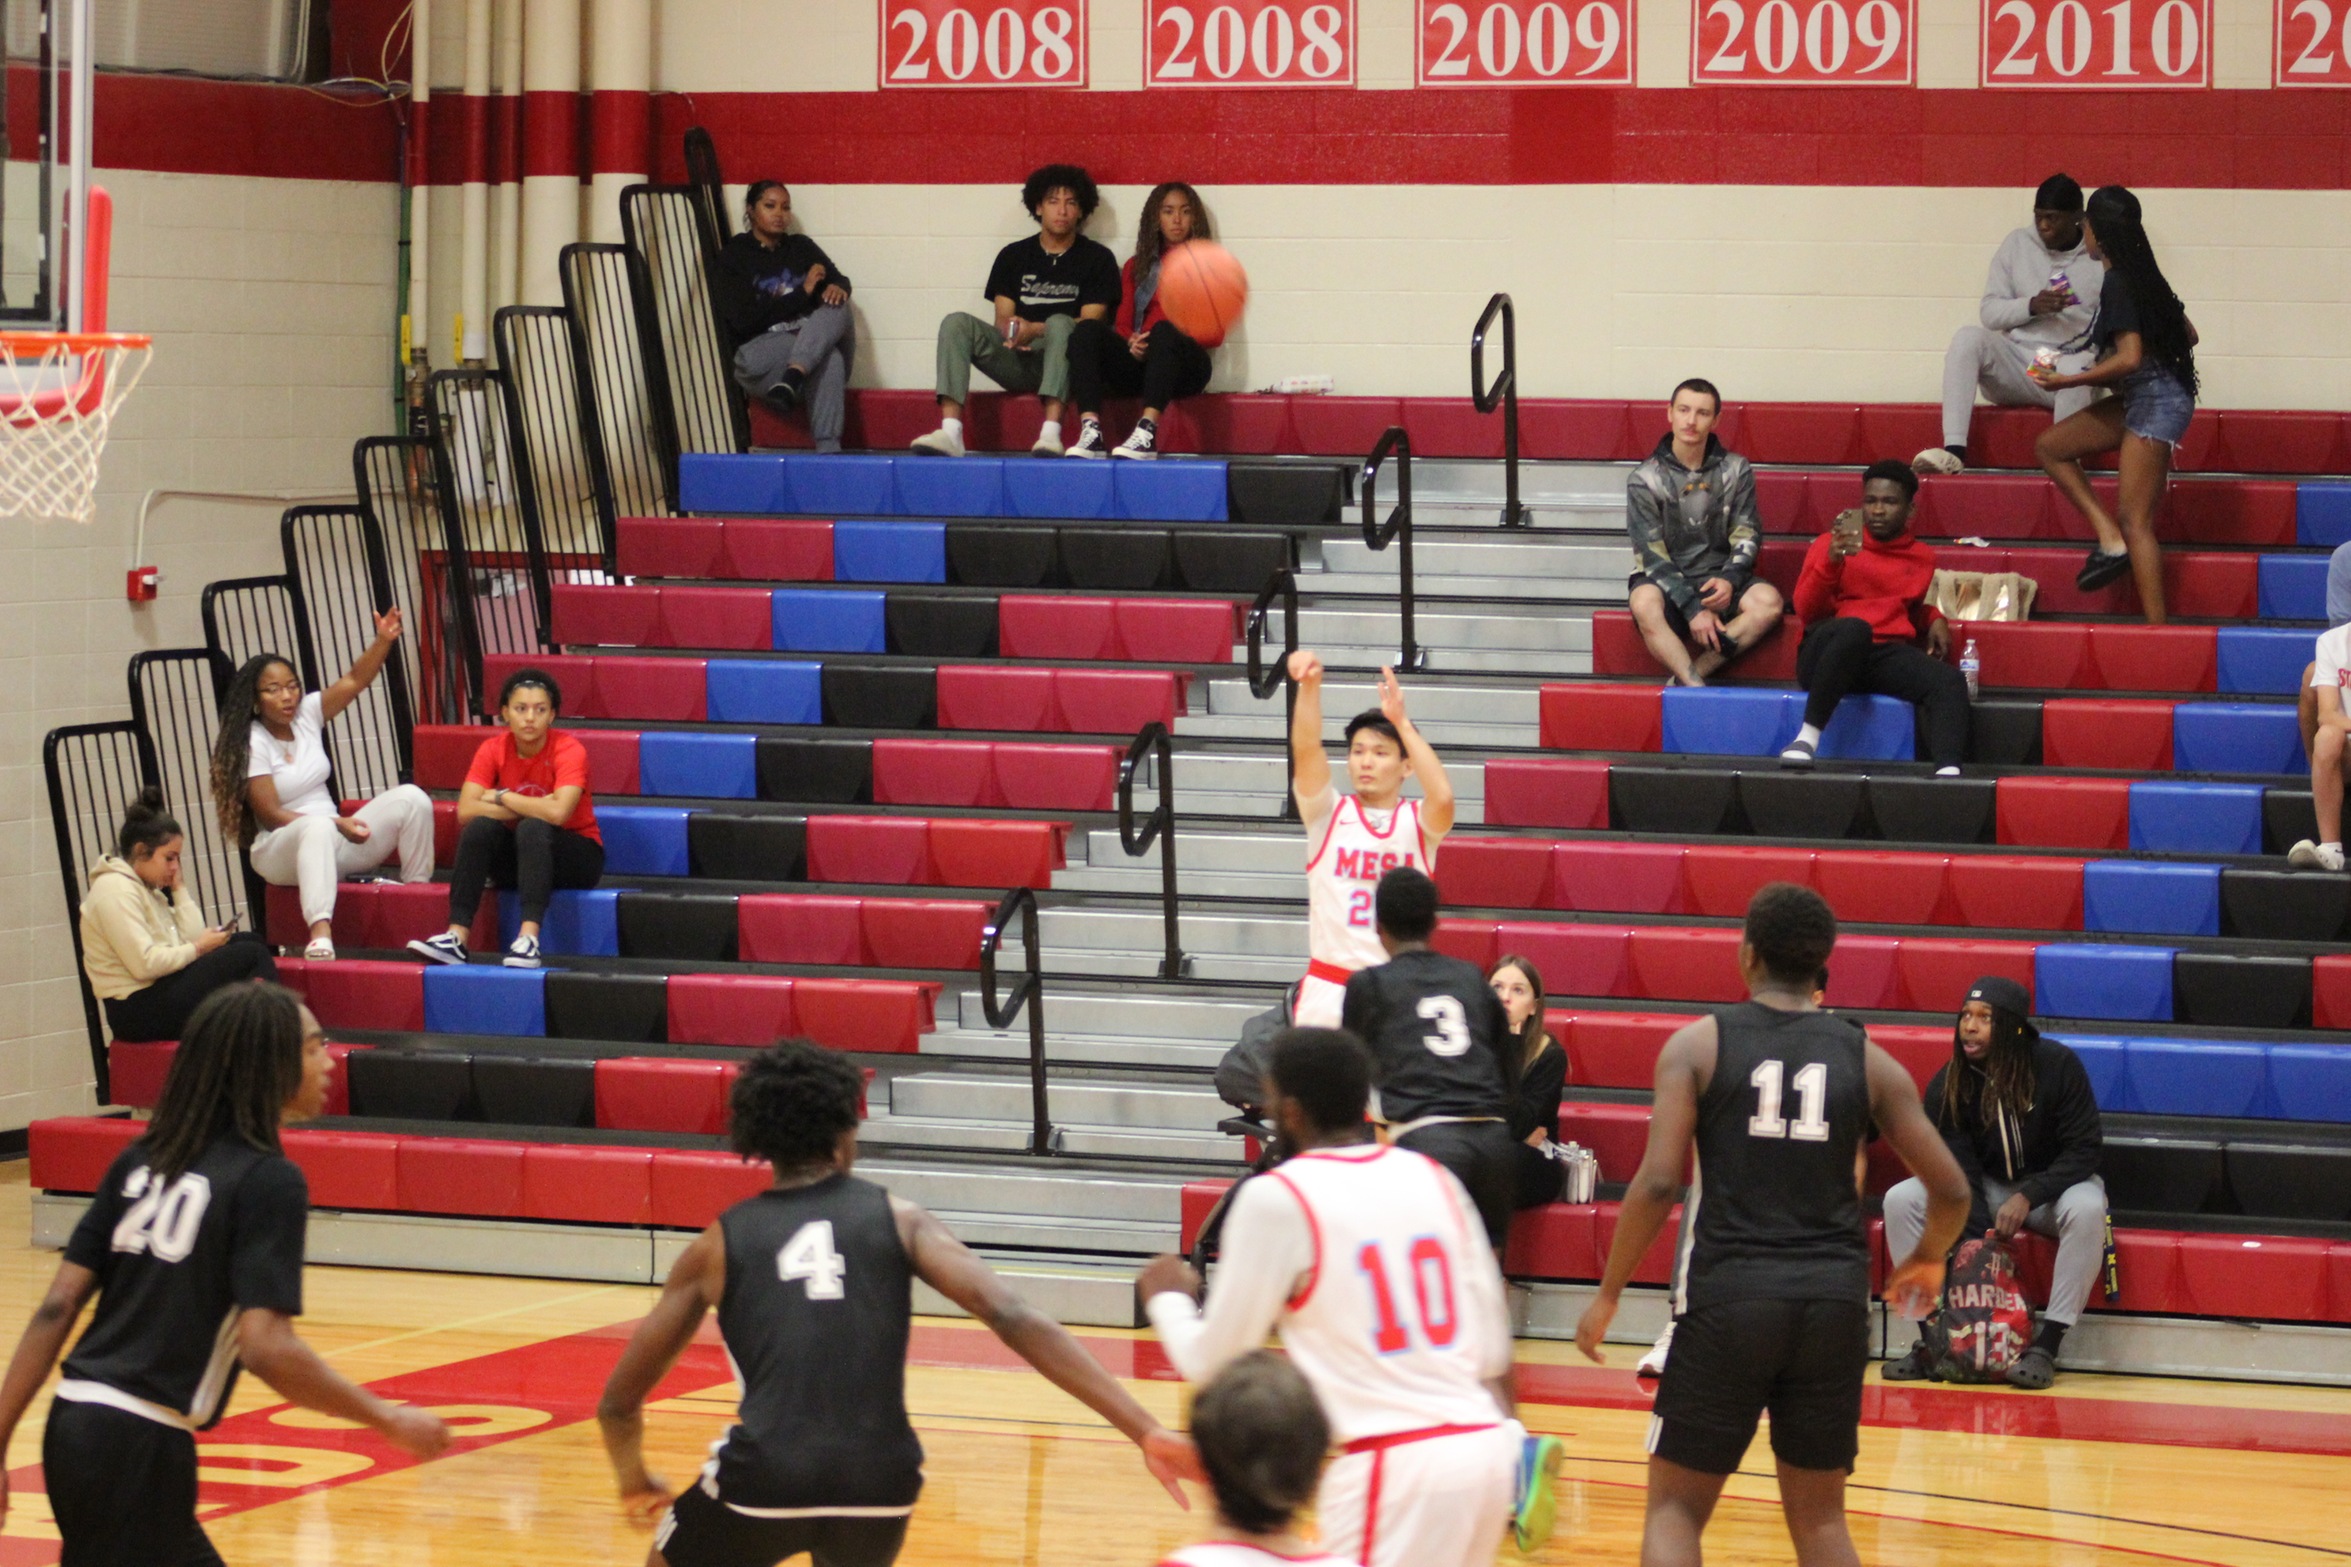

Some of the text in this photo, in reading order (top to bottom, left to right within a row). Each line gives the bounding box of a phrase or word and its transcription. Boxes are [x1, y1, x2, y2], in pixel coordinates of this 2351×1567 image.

[890, 8, 1074, 81] 2008
[1155, 4, 1344, 79] 2008
[1427, 1, 1621, 77] 2009
[1702, 0, 1902, 74] 2009
[1990, 0, 2200, 77] 2010
[1415, 994, 1472, 1057] 3
[1748, 1058, 1830, 1142] 11
[110, 1163, 211, 1264] 20
[775, 1219, 846, 1300] 4
[1357, 1234, 1461, 1357] 10
[1948, 1283, 2028, 1312] HARDEN
[1973, 1320, 2011, 1372] 13
